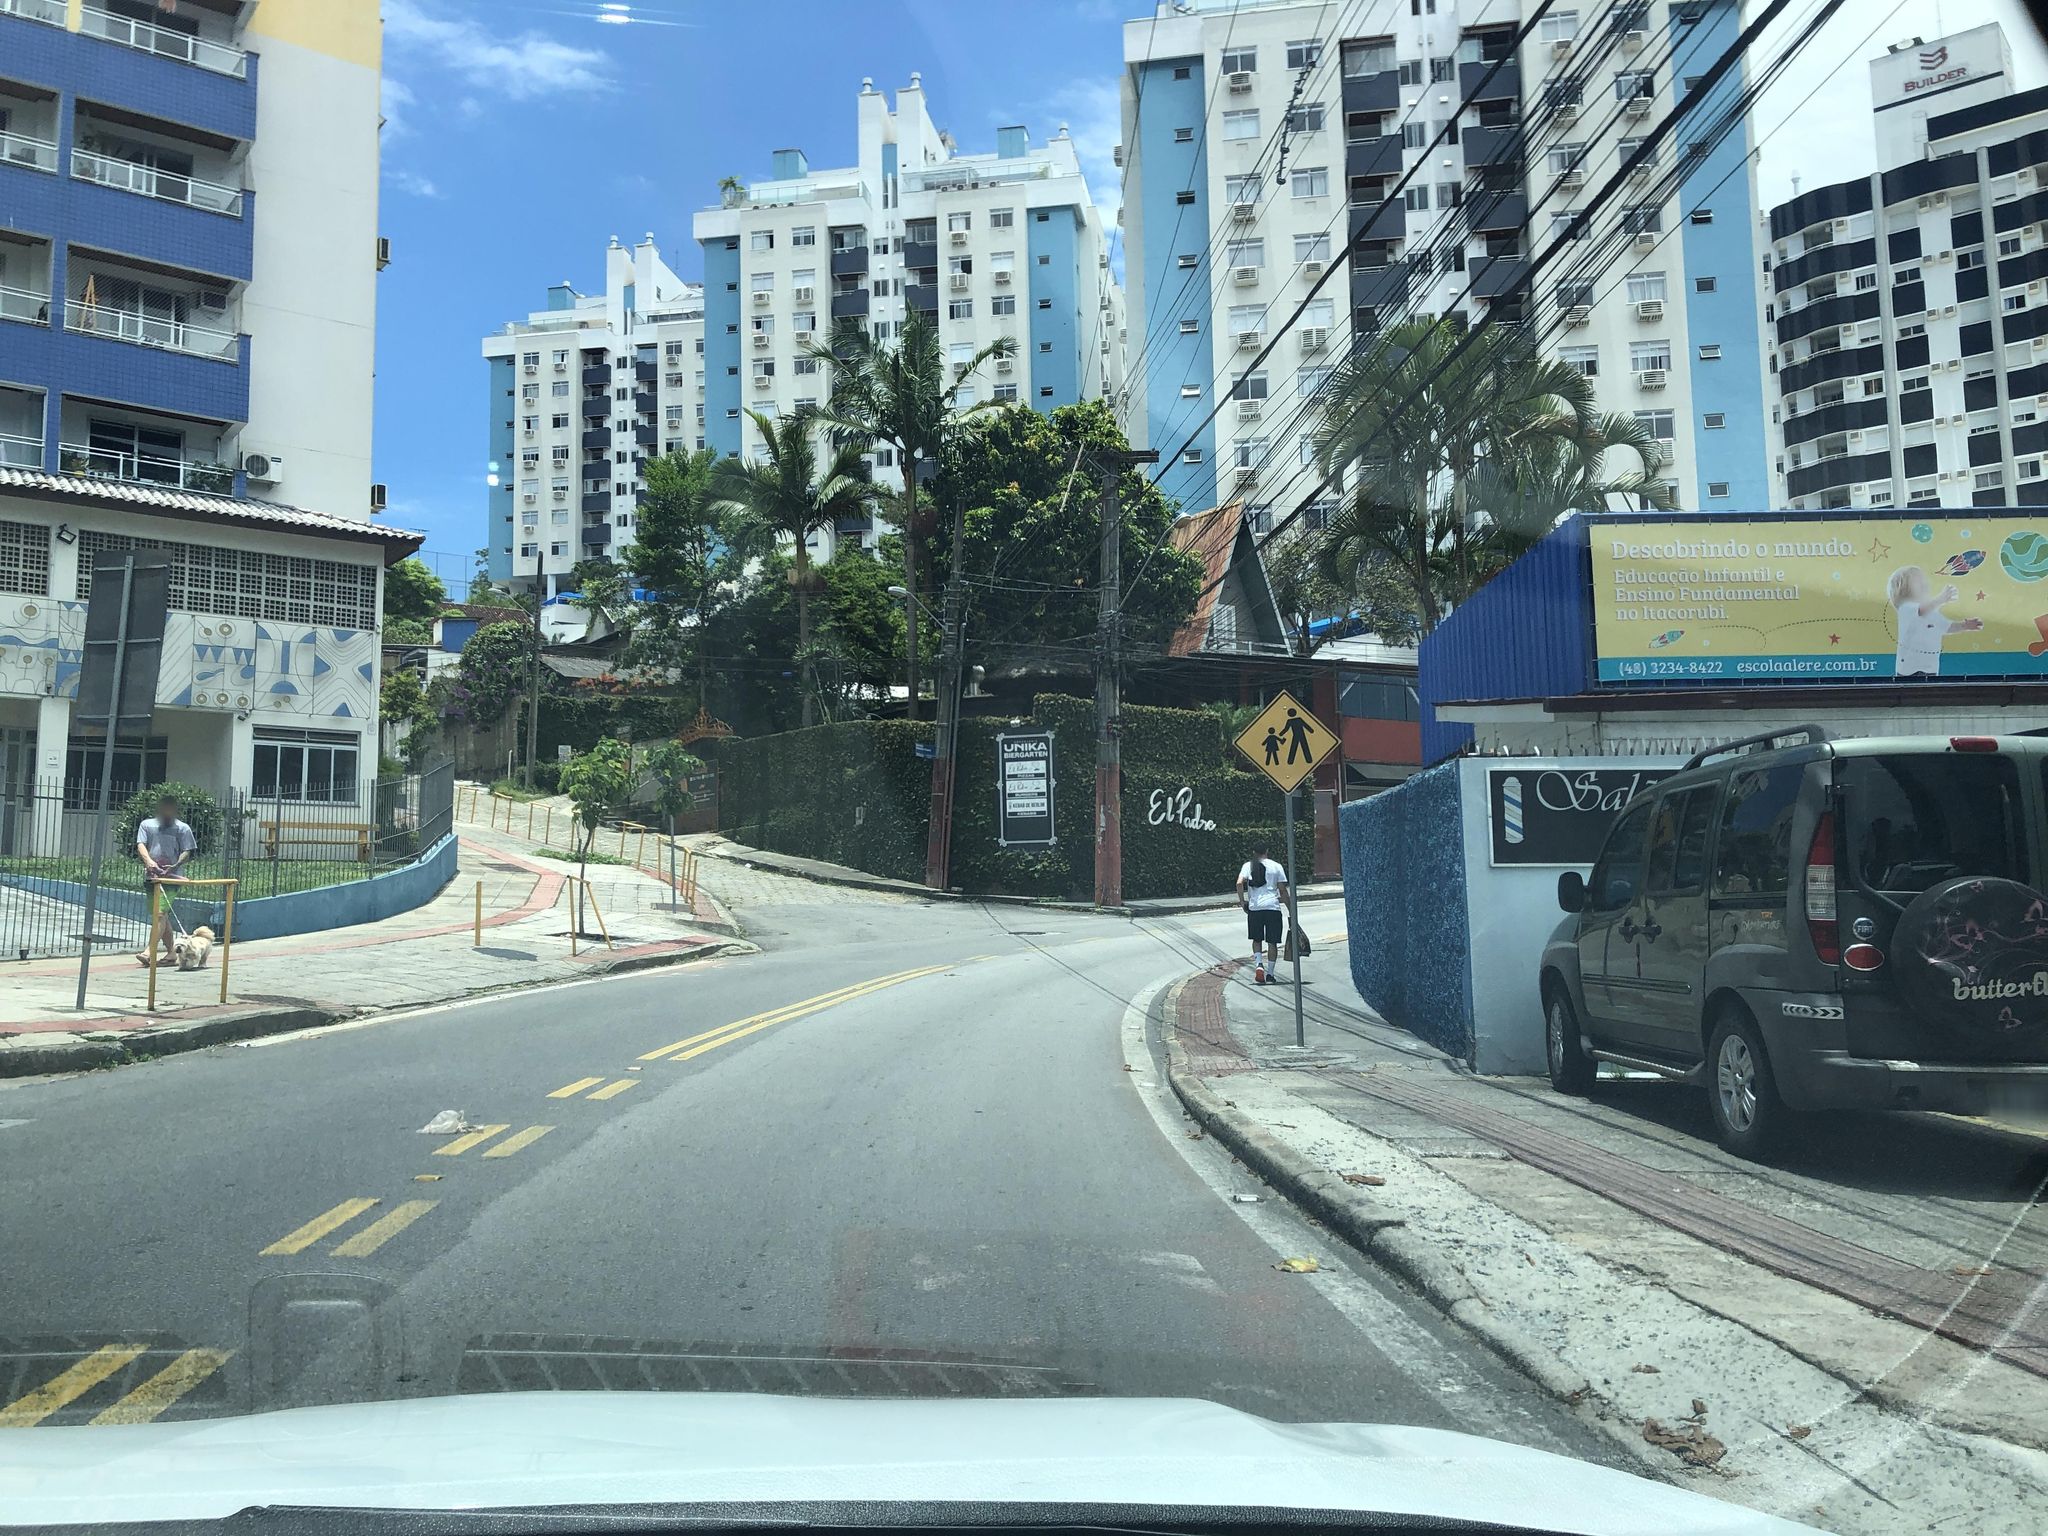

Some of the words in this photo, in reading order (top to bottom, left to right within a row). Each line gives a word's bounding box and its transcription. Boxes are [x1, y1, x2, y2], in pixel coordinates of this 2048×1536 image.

[1904, 67, 1967, 92] BUILDER
[1611, 539, 1750, 560] Descobrindo
[1755, 543, 1767, 558] o
[1773, 538, 1857, 558] mundo.
[1614, 568, 1699, 588] Educação
[1703, 568, 1771, 583] Infantil
[1775, 570, 1785, 582] e
[1615, 587, 1675, 602] Ensino
[1679, 585, 1799, 601] Fundamental
[1616, 608, 1638, 620] no
[1642, 604, 1729, 620] Itacorubi.
[1618, 663, 1647, 677] (48)
[1650, 661, 1723, 675] 3234-8422
[1736, 658, 1878, 673] escolaalere.com.br
[1003, 742, 1048, 752] UNIKA
[1003, 750, 1048, 759] BIERGARTEN
[1149, 788, 1174, 826] El
[1175, 786, 1217, 832] Padre
[1857, 925, 1873, 933] FIAT
